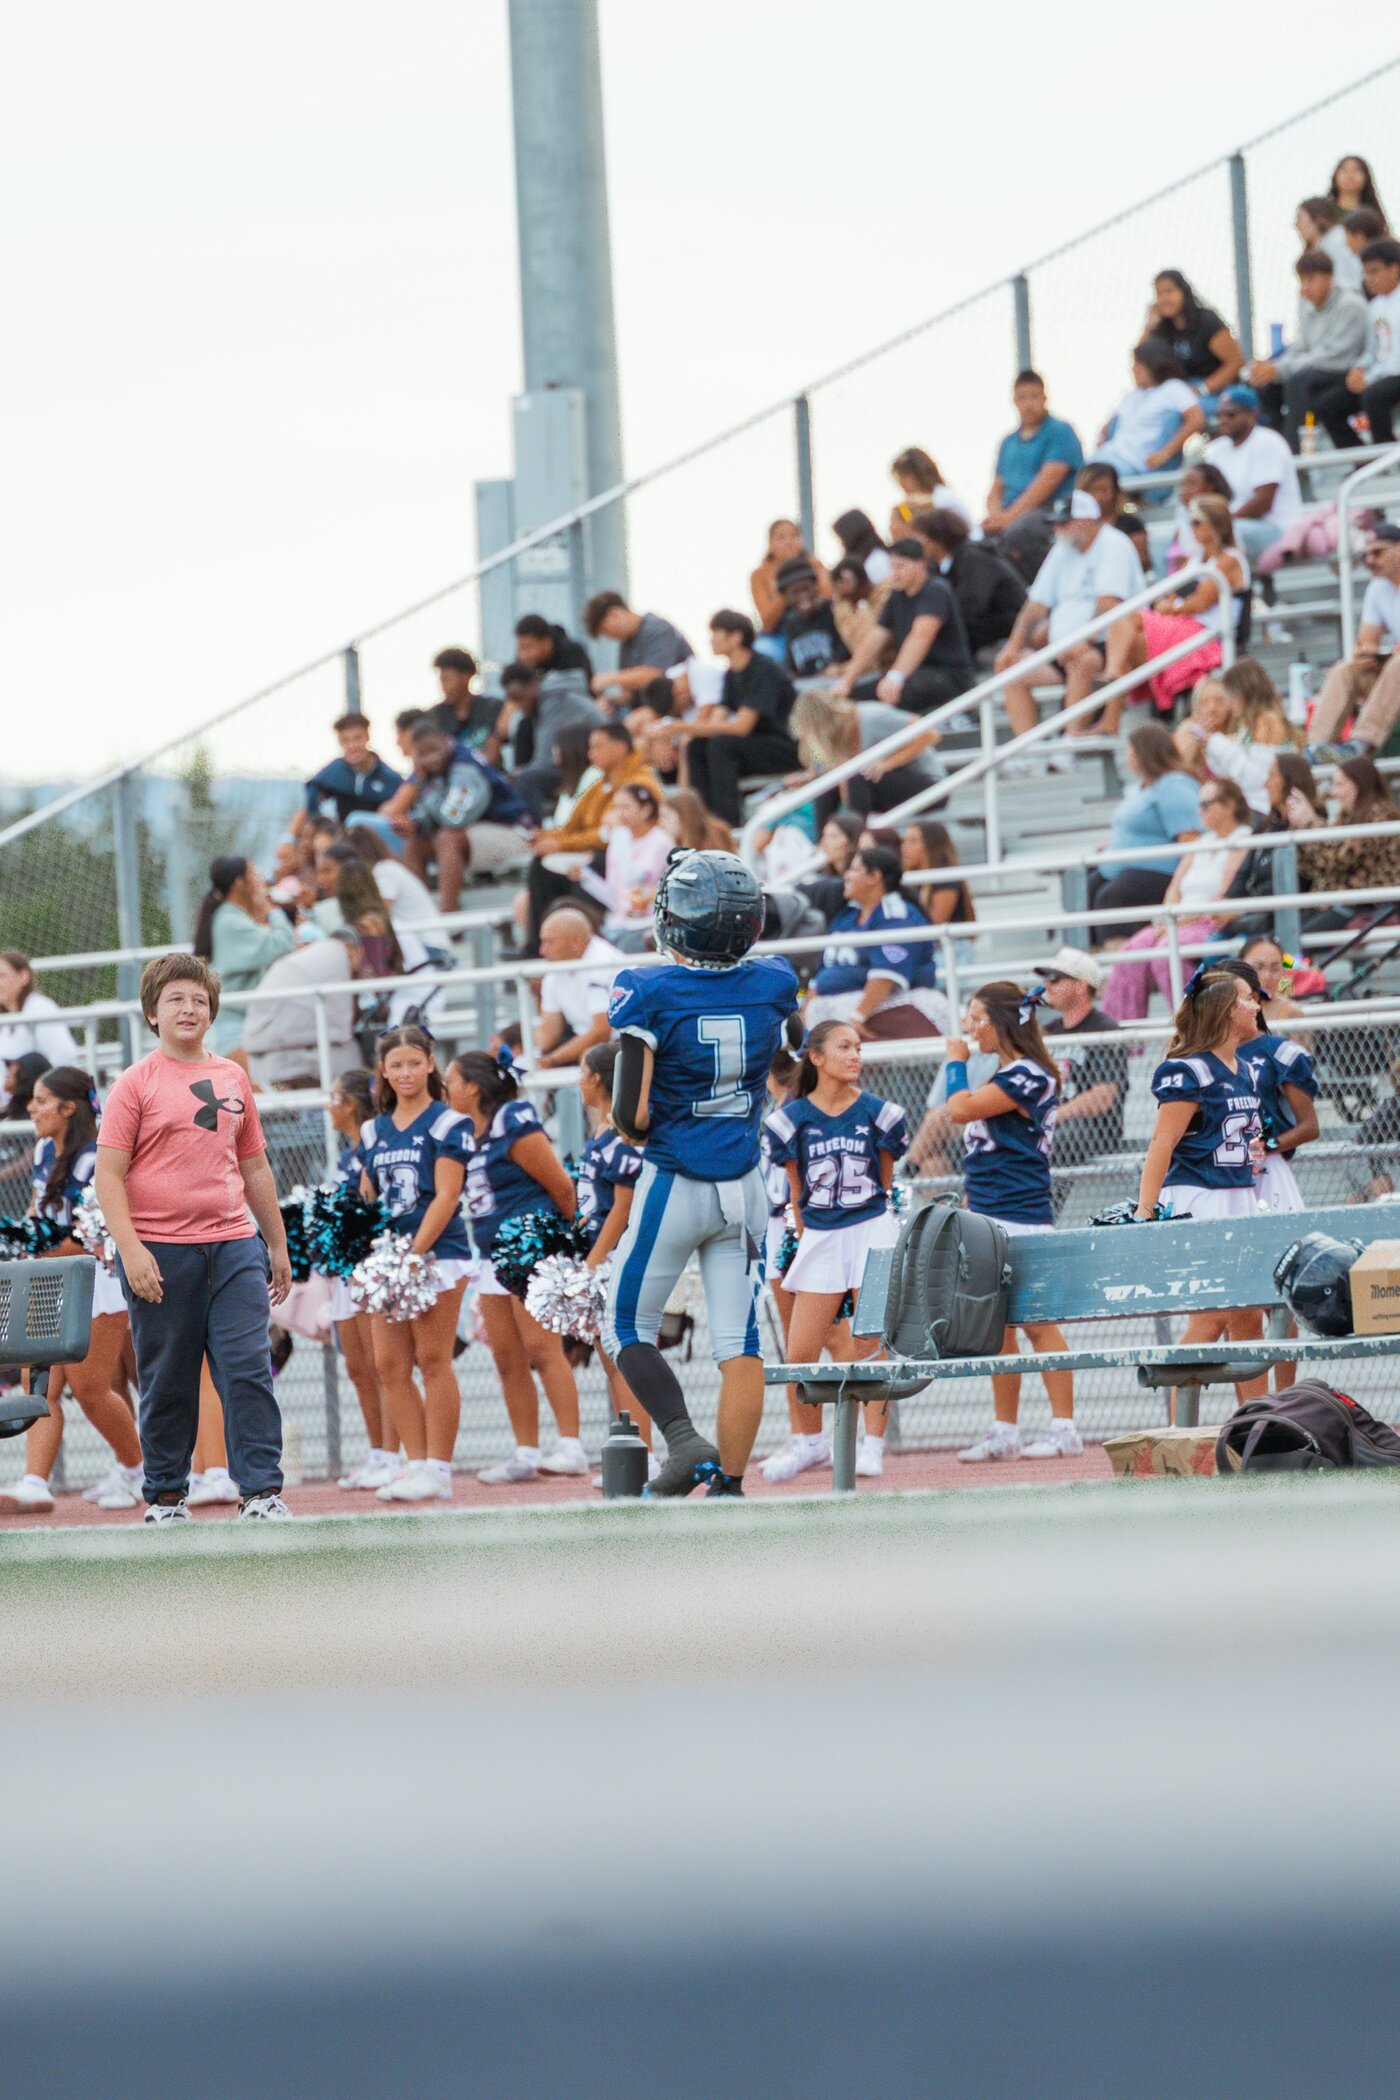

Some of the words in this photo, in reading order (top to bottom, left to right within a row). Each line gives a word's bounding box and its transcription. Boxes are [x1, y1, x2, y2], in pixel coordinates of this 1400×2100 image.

[692, 1014, 752, 1118] 1
[1226, 1096, 1261, 1111] FREED
[372, 1148, 421, 1168] FREEDOM
[808, 1136, 866, 1158] FREEDOM
[618, 1153, 642, 1175] 17
[375, 1163, 420, 1218] 13
[805, 1151, 877, 1209] 25
